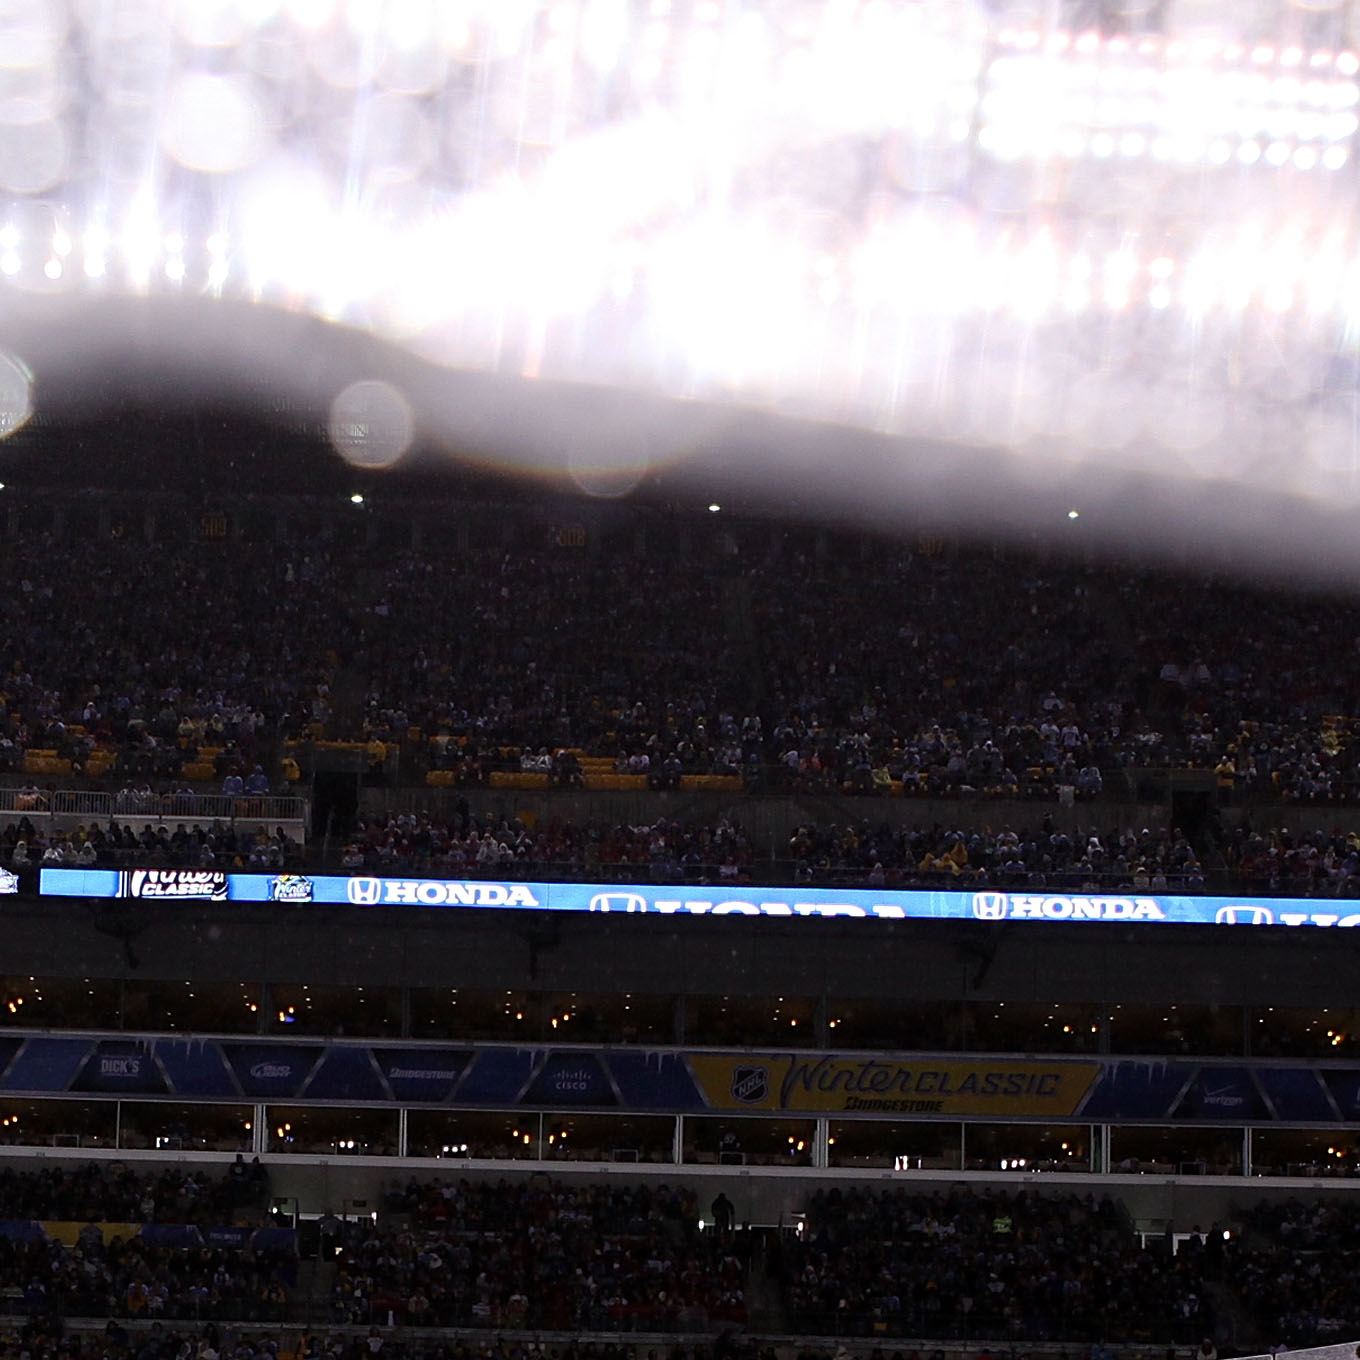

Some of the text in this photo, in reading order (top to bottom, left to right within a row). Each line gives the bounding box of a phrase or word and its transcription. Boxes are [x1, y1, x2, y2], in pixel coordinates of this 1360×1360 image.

[143, 883, 213, 895] CLASSIC
[384, 881, 539, 907] HONDA
[1009, 897, 1166, 919] HONDA
[100, 1057, 140, 1074] DICK'S
[389, 1067, 457, 1081] BRIDGESTONE
[737, 1073, 764, 1098] NHL
[772, 1053, 1061, 1109] Winter CLASSIC
[843, 1096, 945, 1113] BRIDGESTONE
[1202, 1095, 1244, 1108] verizon
